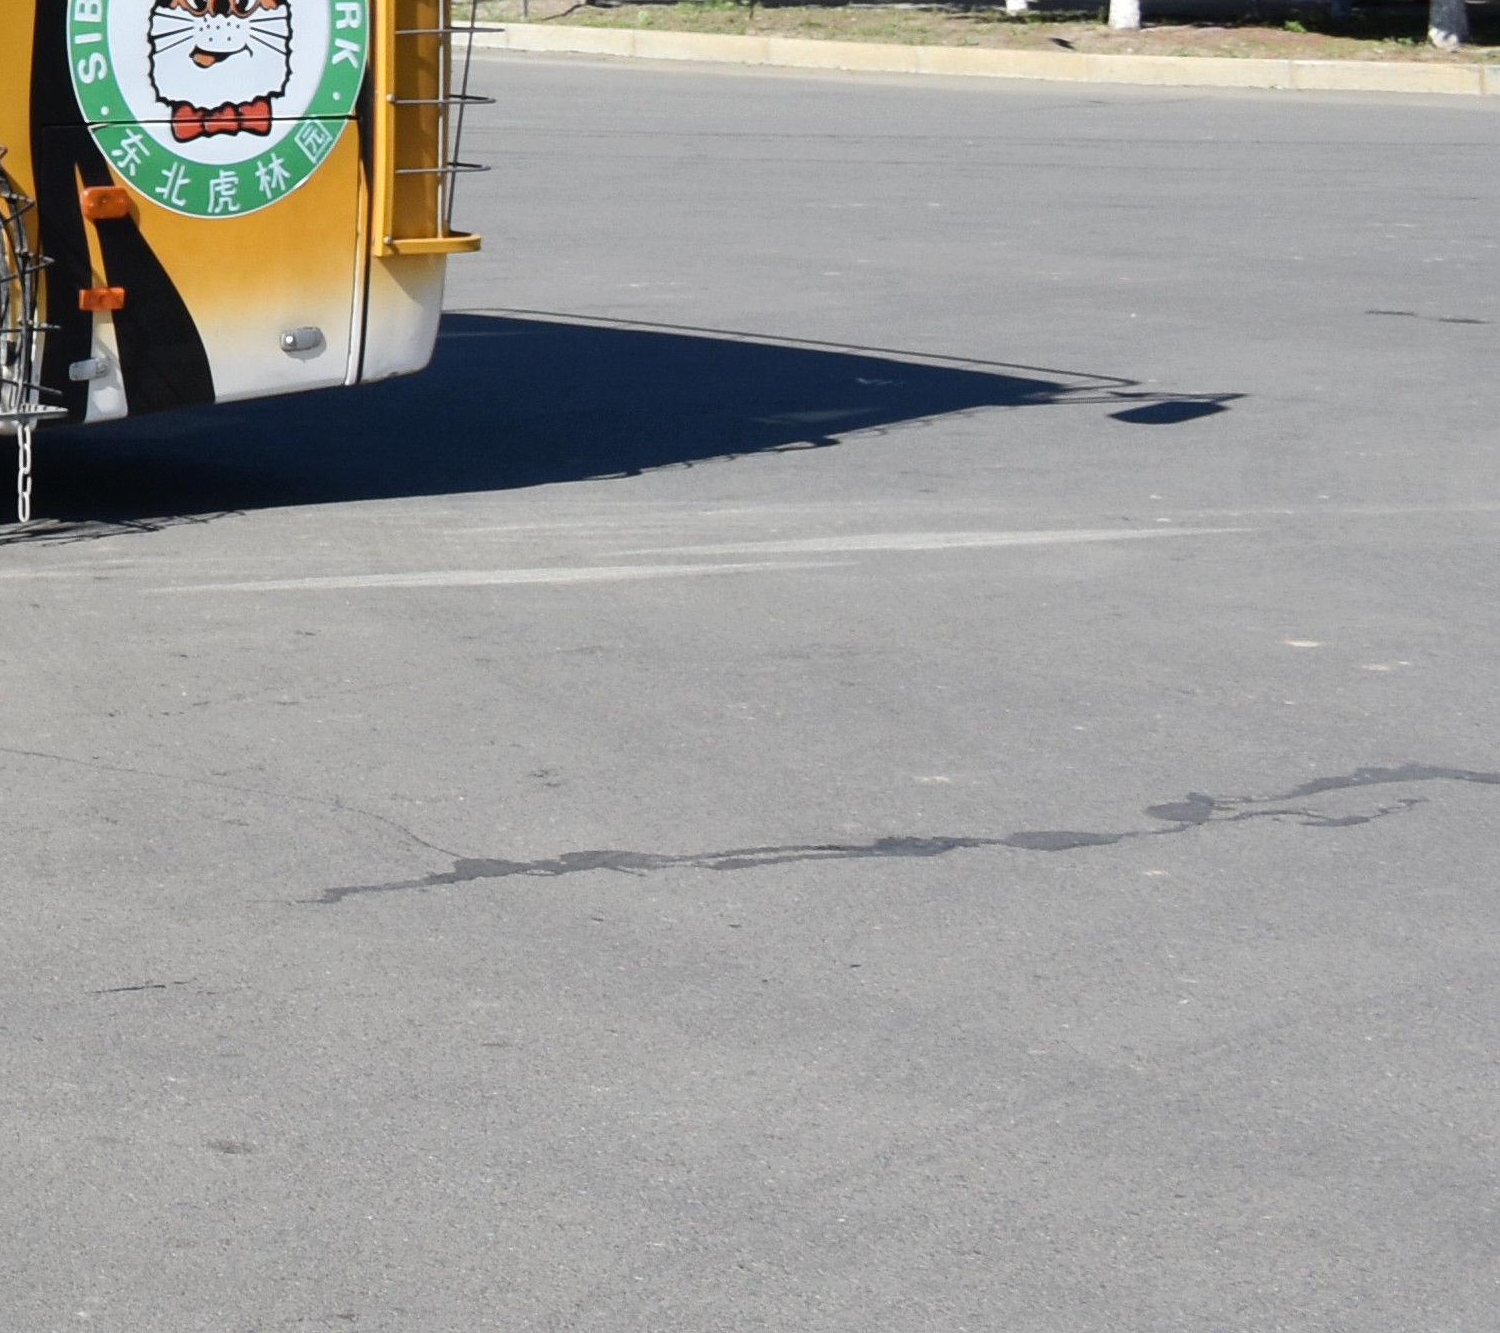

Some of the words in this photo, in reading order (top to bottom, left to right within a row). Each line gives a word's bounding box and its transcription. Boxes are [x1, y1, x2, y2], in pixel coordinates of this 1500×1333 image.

[111, 117, 334, 213] 东北虎林园
